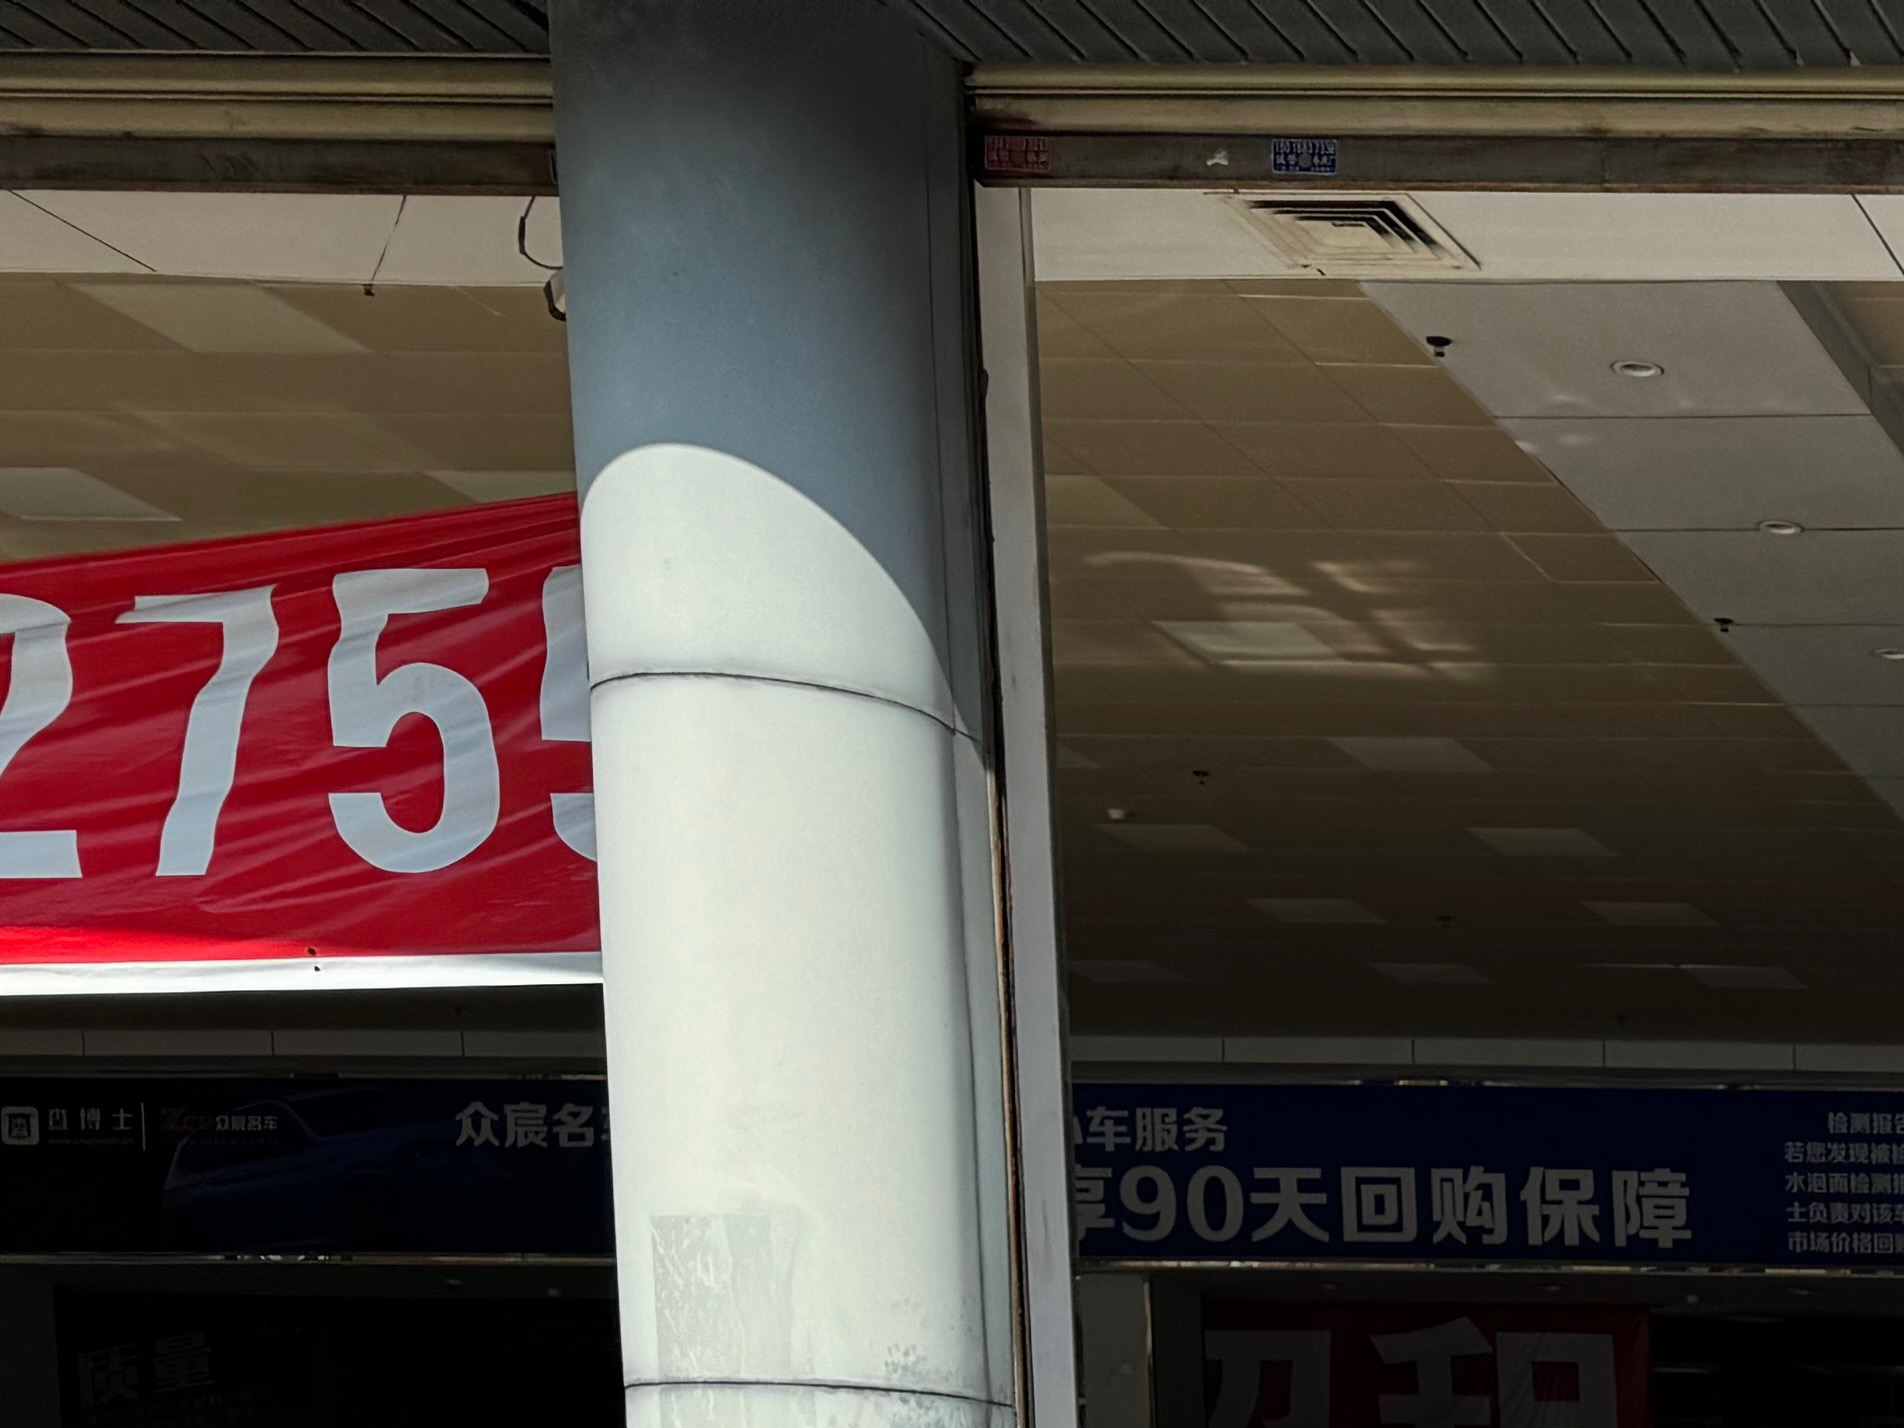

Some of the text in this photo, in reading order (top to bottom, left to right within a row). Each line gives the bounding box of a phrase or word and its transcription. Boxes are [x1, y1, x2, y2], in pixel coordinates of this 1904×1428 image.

[455, 1100, 608, 1150] 众宸名
[1074, 1105, 1229, 1153] 车服务
